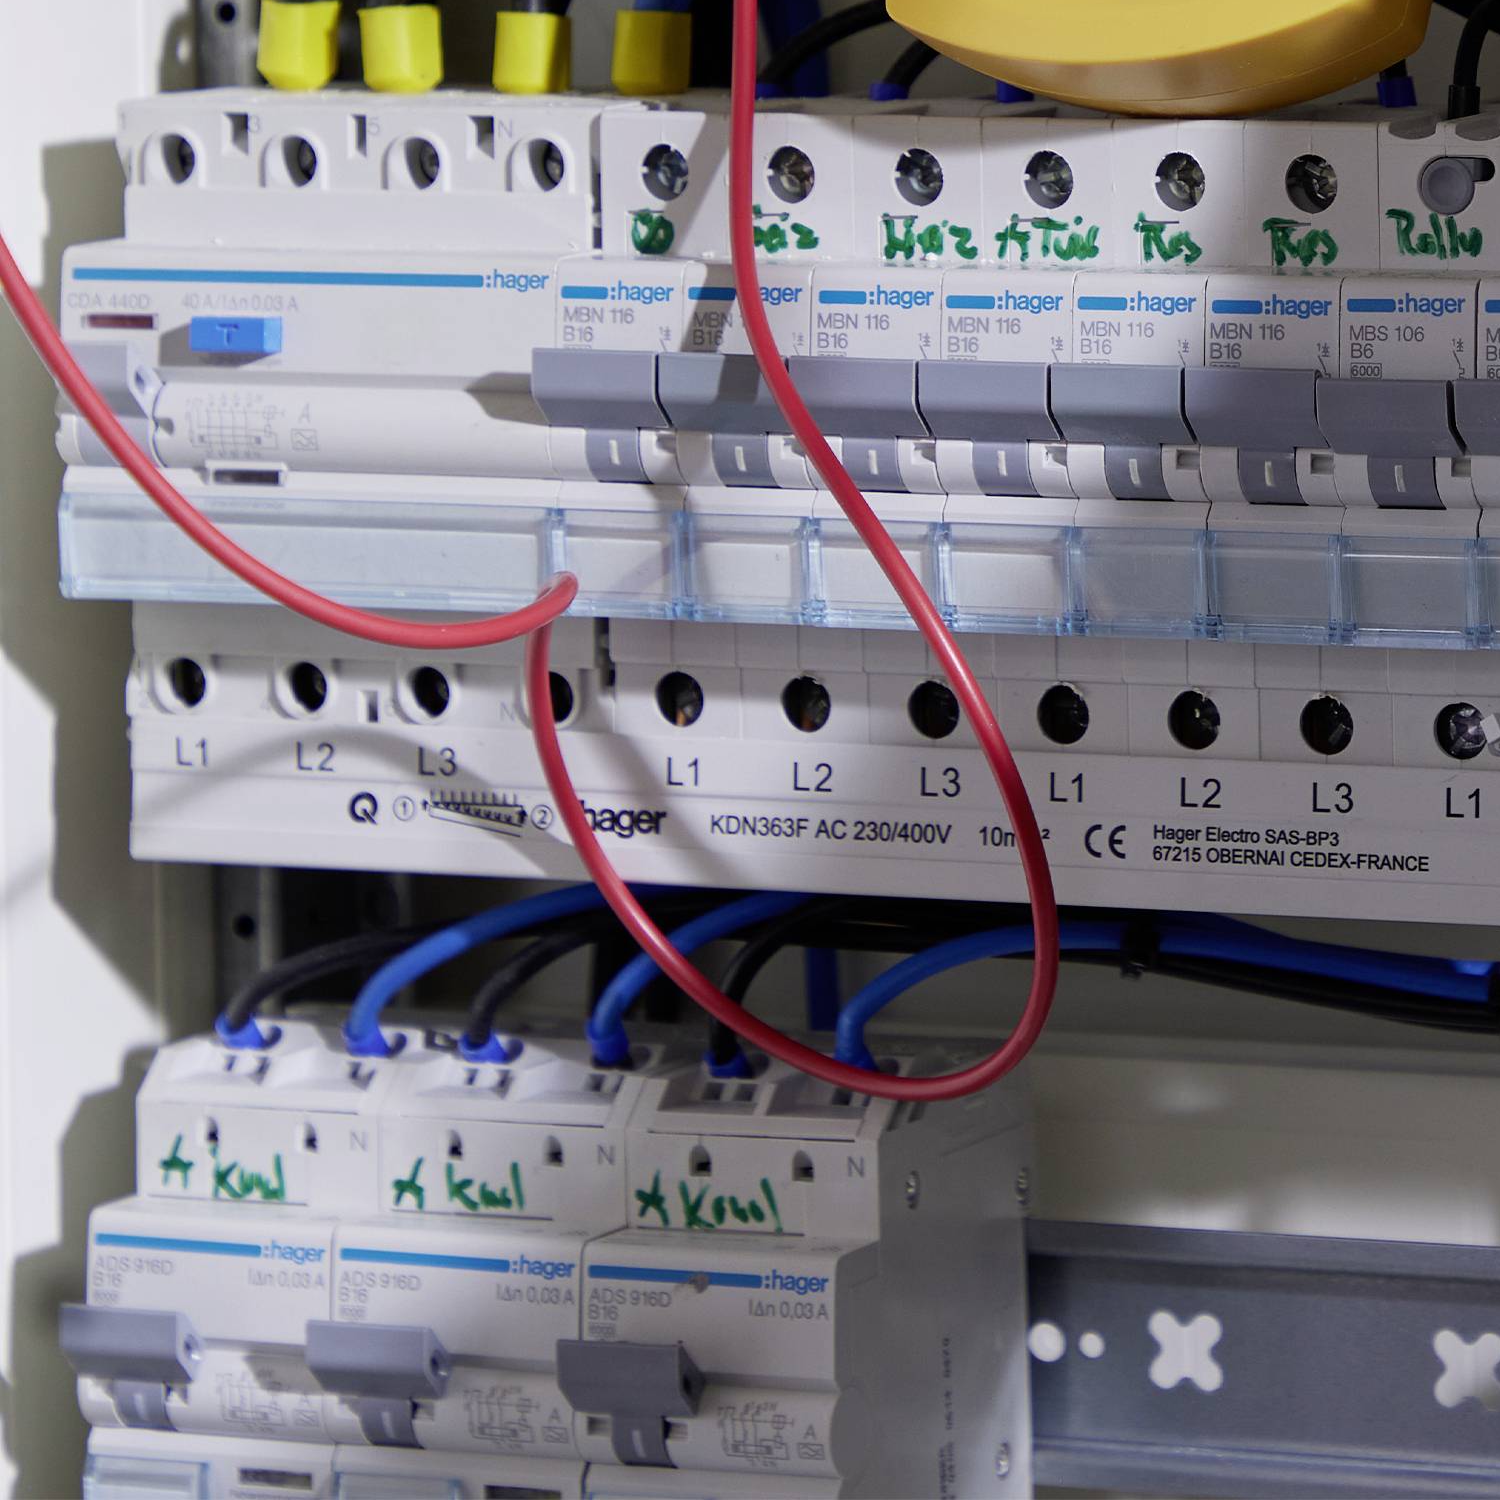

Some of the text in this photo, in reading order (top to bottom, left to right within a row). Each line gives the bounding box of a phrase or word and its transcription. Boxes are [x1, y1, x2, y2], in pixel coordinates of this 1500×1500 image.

[563, 306, 635, 324] MBN 116
[692, 311, 733, 328] MBN
[817, 313, 890, 331] MBN 116
[563, 325, 594, 342] B16
[948, 316, 1021, 335] MBN 116
[1080, 320, 1154, 338] MBN 116
[1210, 323, 1285, 341] MBN 116
[1350, 325, 1425, 343] MBS 106
[692, 329, 724, 346] B16
[817, 332, 848, 349] B16
[948, 336, 979, 353] B16
[1080, 339, 1112, 355] B16
[1210, 343, 1242, 360] B16
[1350, 343, 1374, 359] B6
[1351, 365, 1381, 377] 6000
[176, 736, 209, 767] L1
[296, 741, 335, 772] L2
[417, 746, 459, 777] L3
[667, 757, 700, 787] L1
[792, 761, 833, 793] L2
[920, 766, 961, 797] L3
[1049, 771, 1084, 803] L1
[1179, 776, 1222, 809] L2
[1311, 782, 1354, 813] L3
[1445, 788, 1482, 819] L1
[349, 791, 379, 825] Q
[710, 814, 809, 839] KDN363F
[815, 818, 847, 840] AC
[853, 820, 952, 845] 230/400V
[1153, 824, 1340, 847] Hager Electro SAS-BP3
[1152, 845, 1430, 872] 67215 OBERNAI CEDEX-FRANCE
[349, 1131, 367, 1151] N
[597, 1145, 615, 1165] N
[847, 1157, 865, 1177] N
[589, 1287, 673, 1308] ADS 916D
[588, 1304, 618, 1321] B16
[817, 1303, 829, 1320] A
